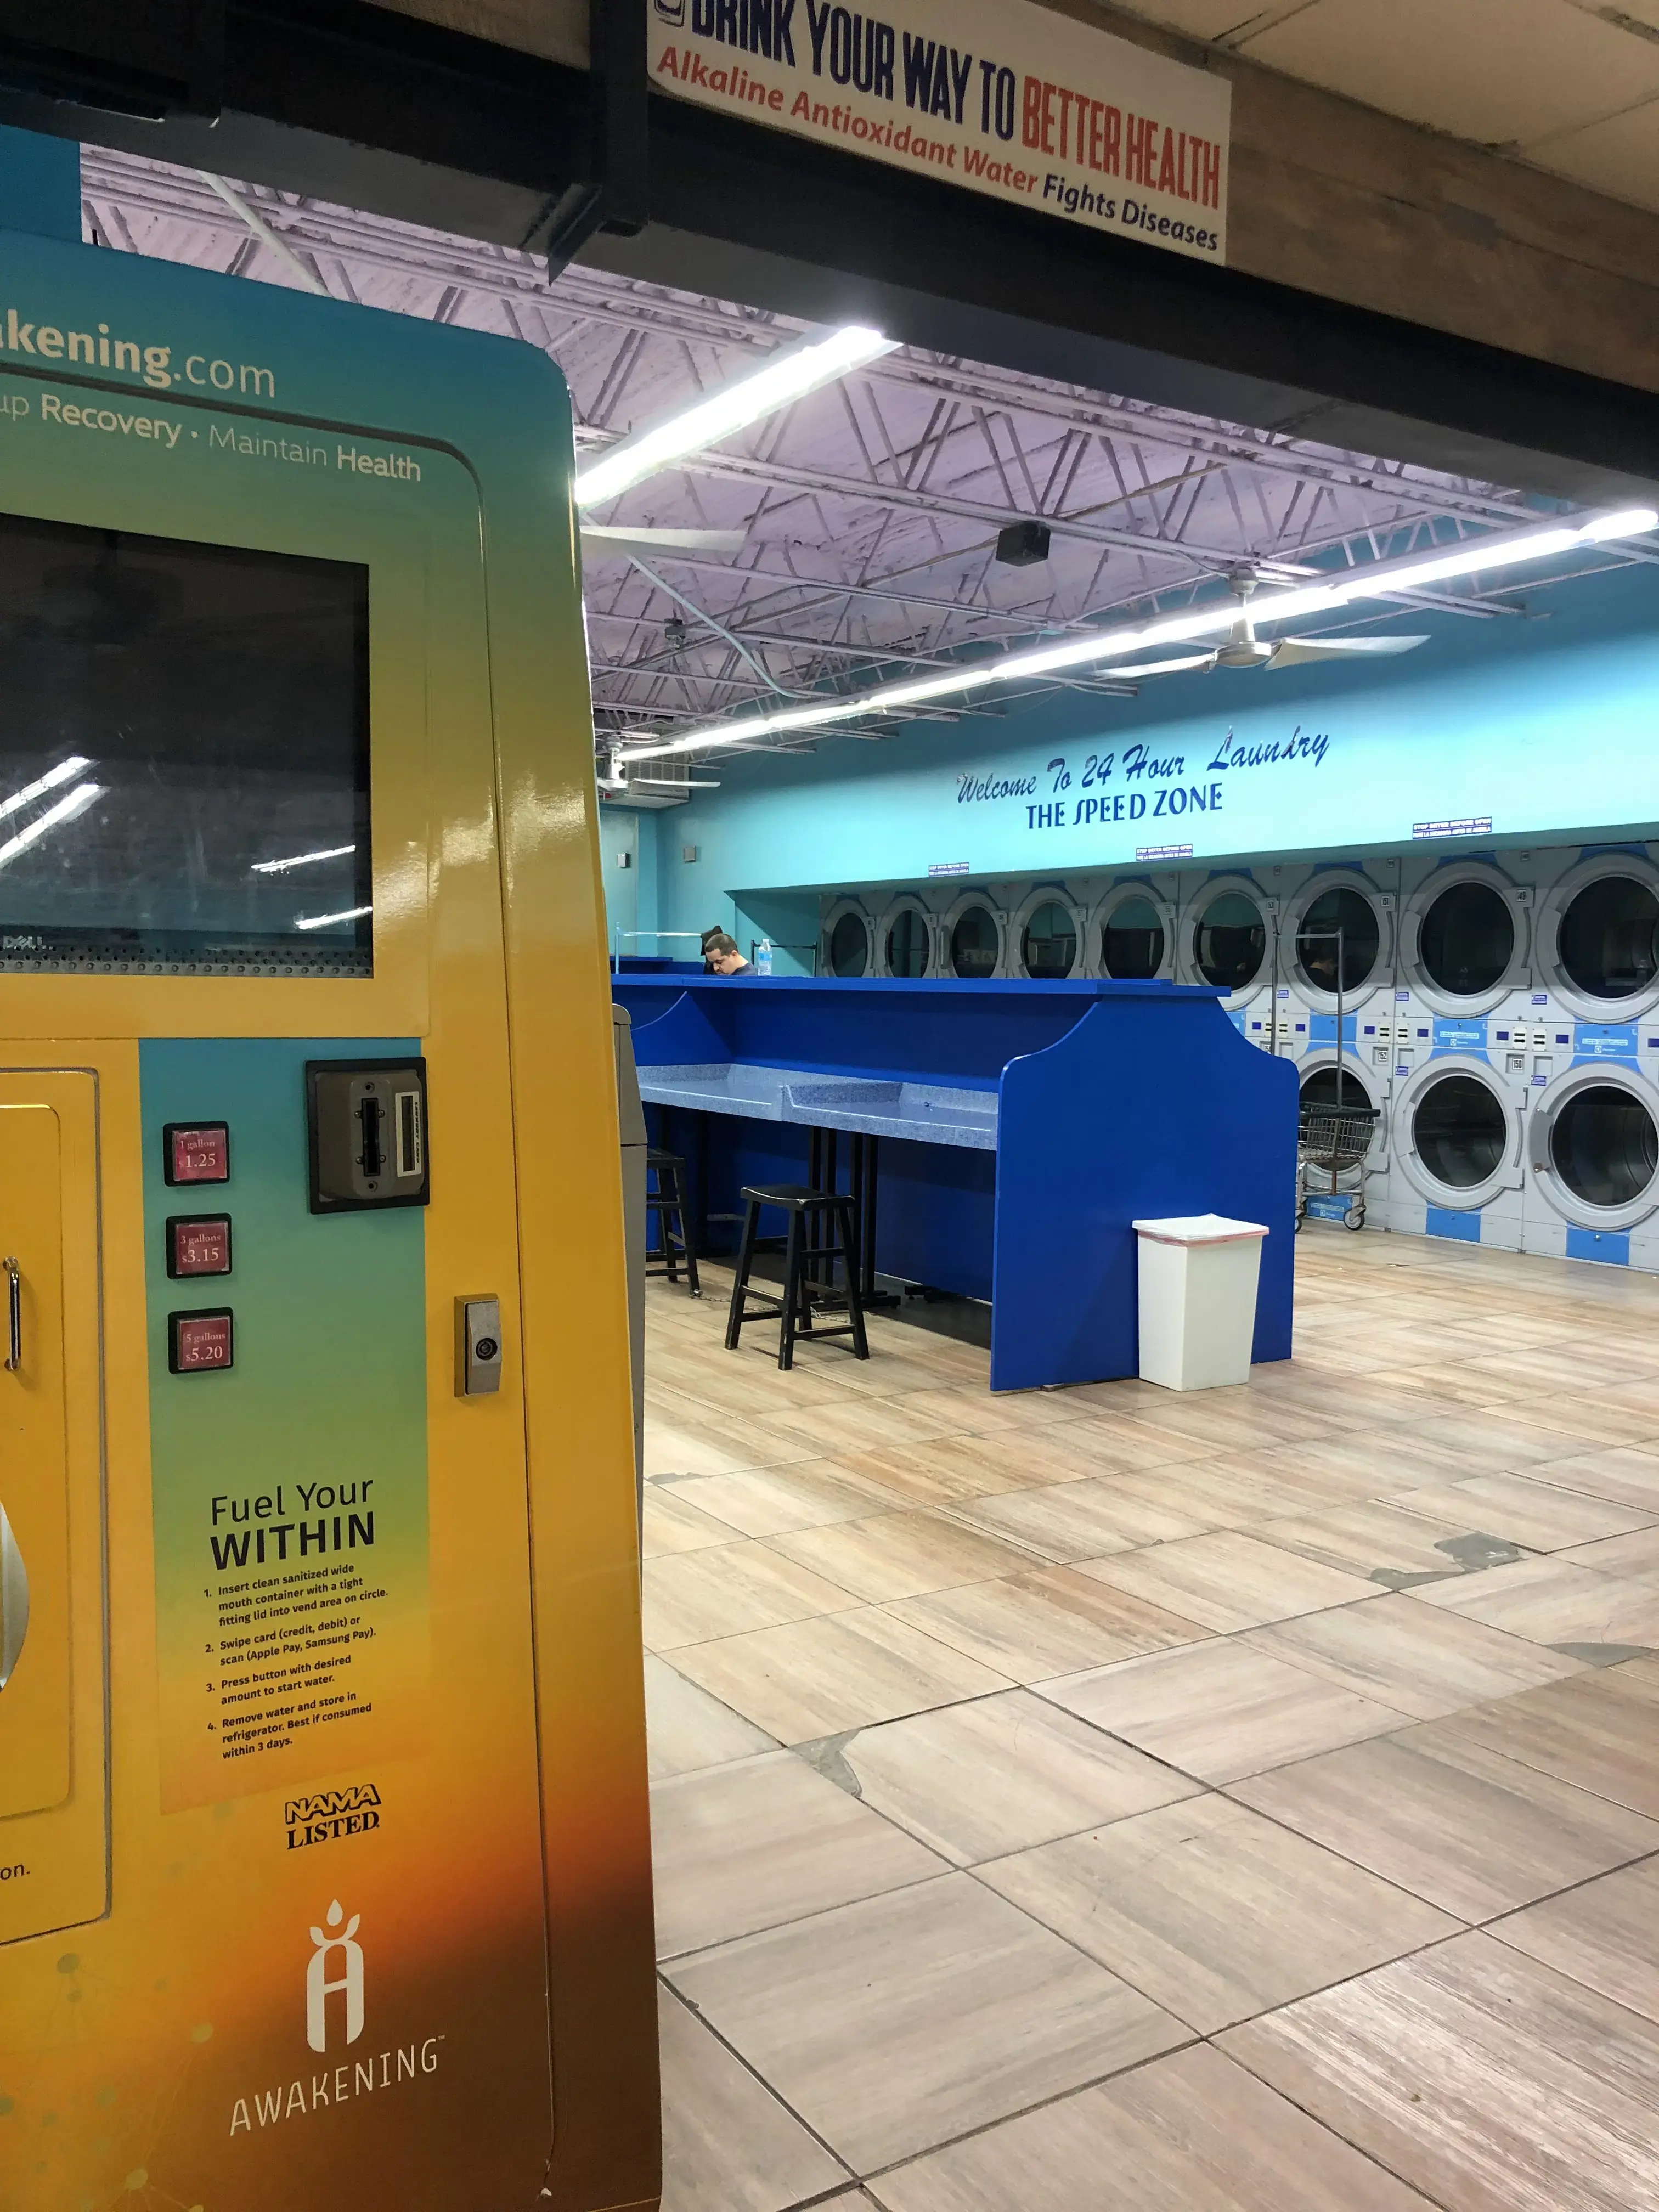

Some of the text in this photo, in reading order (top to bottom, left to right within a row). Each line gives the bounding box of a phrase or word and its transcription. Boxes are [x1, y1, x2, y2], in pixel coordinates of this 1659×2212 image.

[806, 0, 895, 101] YOUR
[902, 31, 973, 125] WAY
[979, 59, 1016, 142] TO
[1022, 75, 1121, 178] BETTER
[1125, 114, 1221, 210] HEALTH
[656, 46, 1218, 252] Alkaline Antioxidant Water Fights Diseases
[0, 308, 275, 398] kening.com
[41, 393, 182, 449] Recovery
[208, 424, 328, 467] Maintain
[337, 444, 422, 482] Health
[956, 725, 1331, 804] Welcome To 24 Hour Laundry
[1025, 782, 1223, 830] THE SPEED ZONE
[1514, 1059, 1522, 1069] 150
[180, 1138, 216, 1152] 1 gallon
[180, 1233, 222, 1246] 3 gallons
[186, 1332, 227, 1345] 5 gallons
[211, 1479, 374, 1526] Fuel Your
[210, 1510, 375, 1571] WITHIN
[204, 1564, 354, 1598] 1. Insert clean sanitized wide
[219, 1596, 253, 1611] mouth
[255, 1588, 304, 1605] container
[306, 1583, 329, 1596] with
[339, 1577, 363, 1590] tight
[219, 1588, 389, 1627] fitting lid into vend area on circle.
[205, 1616, 362, 1653] 2. Swipe card (credit, debit) or
[219, 1626, 377, 1666] scan (Apple Pay, Samsung Pay).
[206, 1654, 352, 1692] 3. Press button with desired
[221, 1675, 335, 1705] amount to start water.
[207, 1691, 357, 1731] 4. Remove water and store in
[222, 1702, 372, 1744] refrigerator. Best if consumed
[222, 1737, 294, 1759] within 3 days.
[285, 1782, 382, 1825] NAMA
[286, 1810, 380, 1850] LISTED
